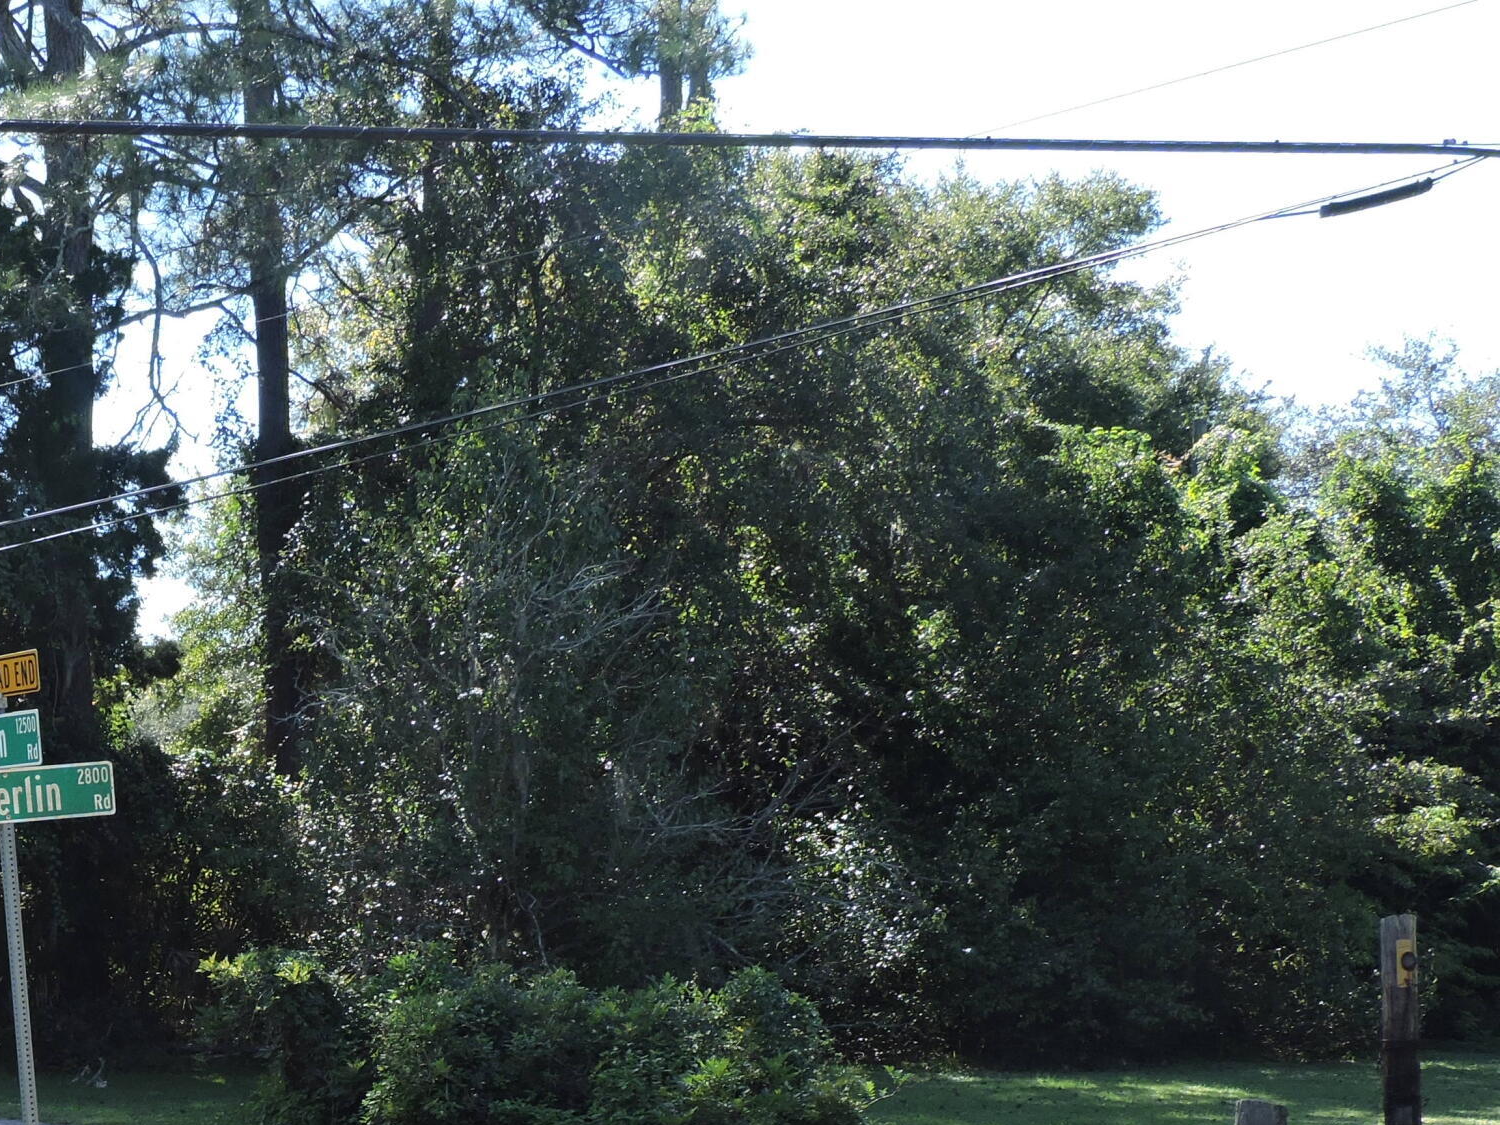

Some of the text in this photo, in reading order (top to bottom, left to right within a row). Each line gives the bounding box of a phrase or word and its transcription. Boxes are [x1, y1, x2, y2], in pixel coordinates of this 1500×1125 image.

[16, 659, 35, 687] END
[15, 716, 37, 734] 12500
[27, 743, 39, 760] Rd
[77, 767, 109, 785] 2800
[94, 794, 111, 810] Rd
